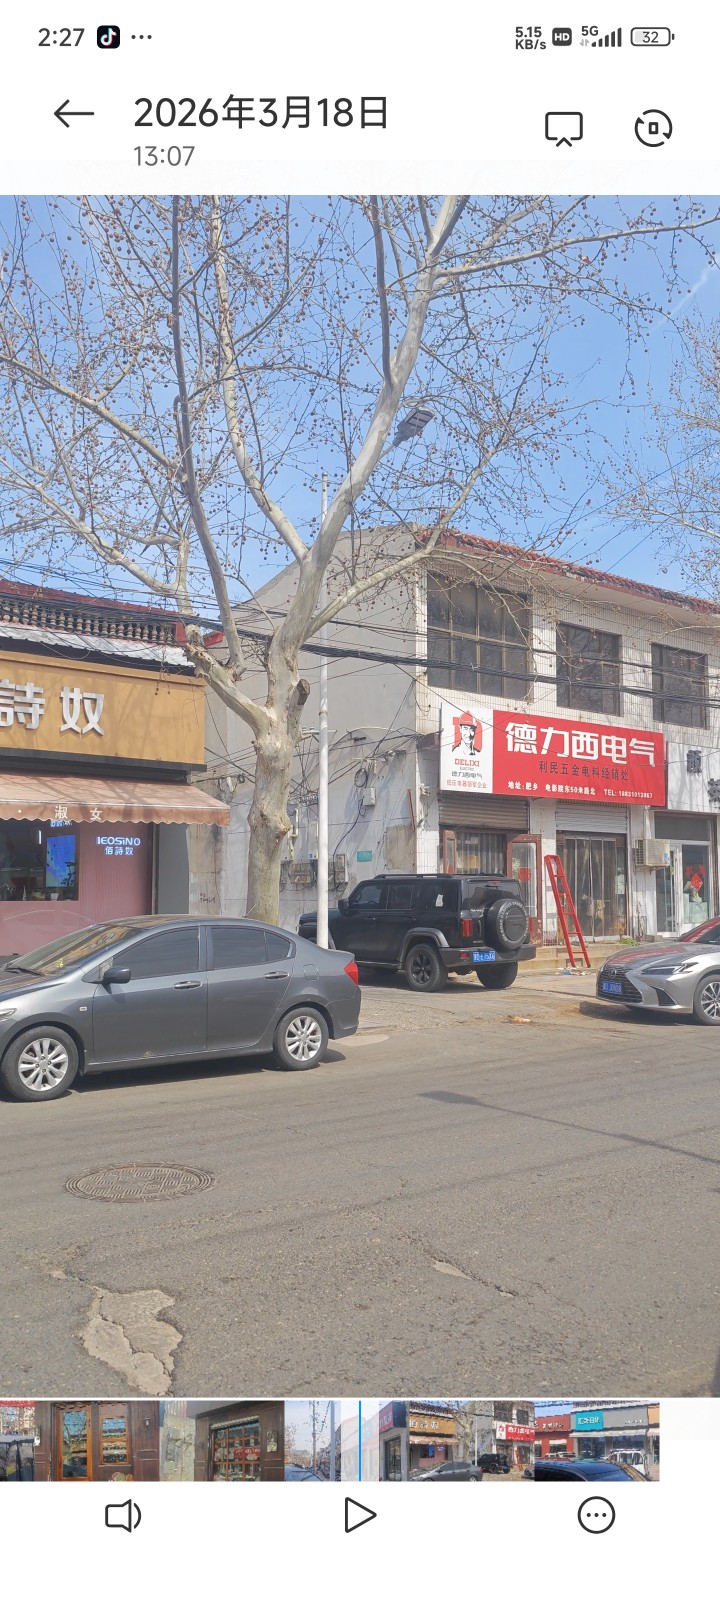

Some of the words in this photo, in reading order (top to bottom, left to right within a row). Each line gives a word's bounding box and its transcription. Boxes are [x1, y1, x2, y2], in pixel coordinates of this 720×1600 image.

[504, 721, 656, 767] 德力西电气
[454, 758, 480, 767] DELIXI
